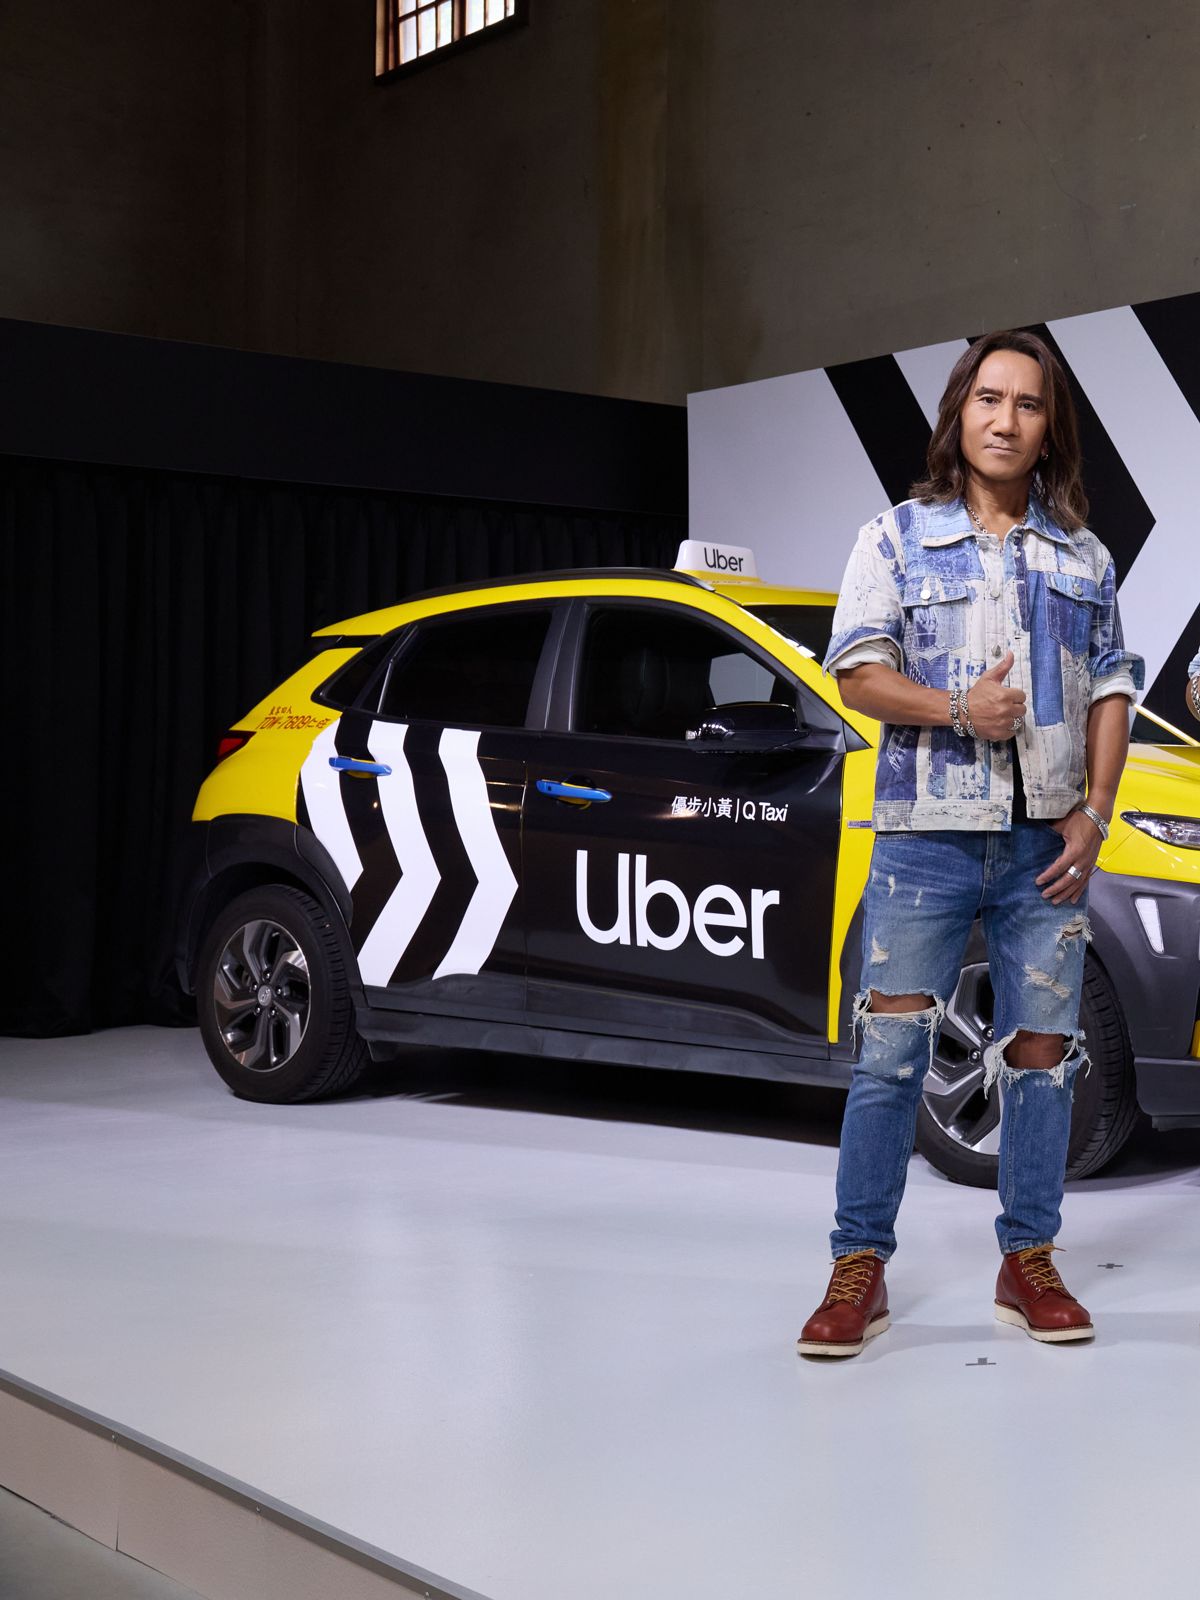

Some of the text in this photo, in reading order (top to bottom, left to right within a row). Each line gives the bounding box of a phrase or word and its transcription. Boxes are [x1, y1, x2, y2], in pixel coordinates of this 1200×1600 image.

[703, 547, 744, 572] Uber
[742, 800, 756, 821] Q
[758, 801, 789, 822] Taxi
[576, 849, 780, 960] Uber
